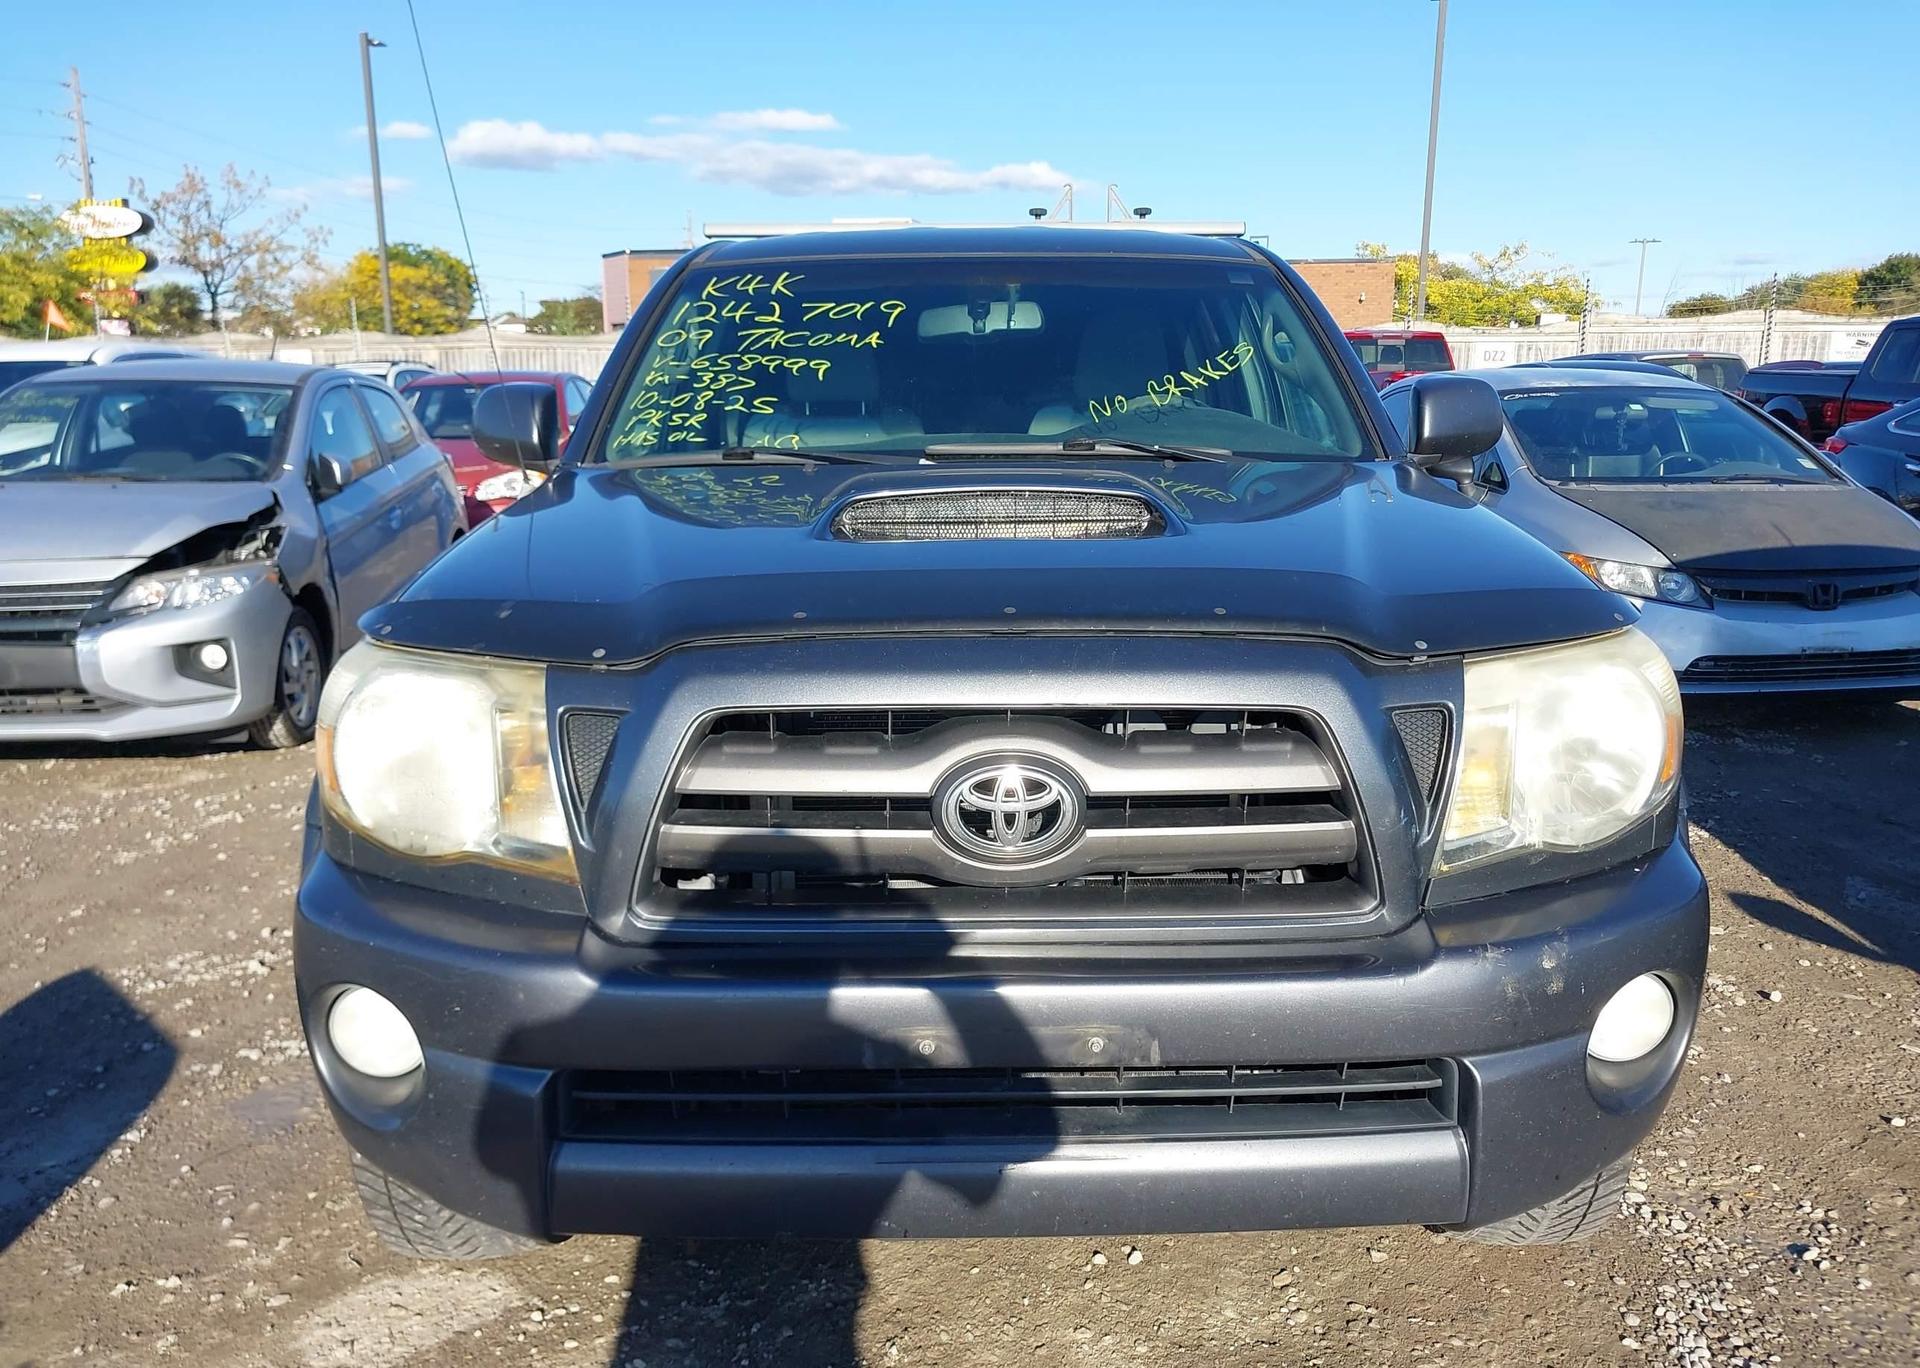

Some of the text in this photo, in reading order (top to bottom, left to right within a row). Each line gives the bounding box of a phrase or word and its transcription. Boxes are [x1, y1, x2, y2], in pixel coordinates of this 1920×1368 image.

[702, 272, 804, 299] K4K
[673, 300, 906, 327] 1242 7019
[657, 327, 884, 351] 09 TACOMA
[1483, 350, 1506, 361] DZ2
[1147, 341, 1254, 407] BRAKES
